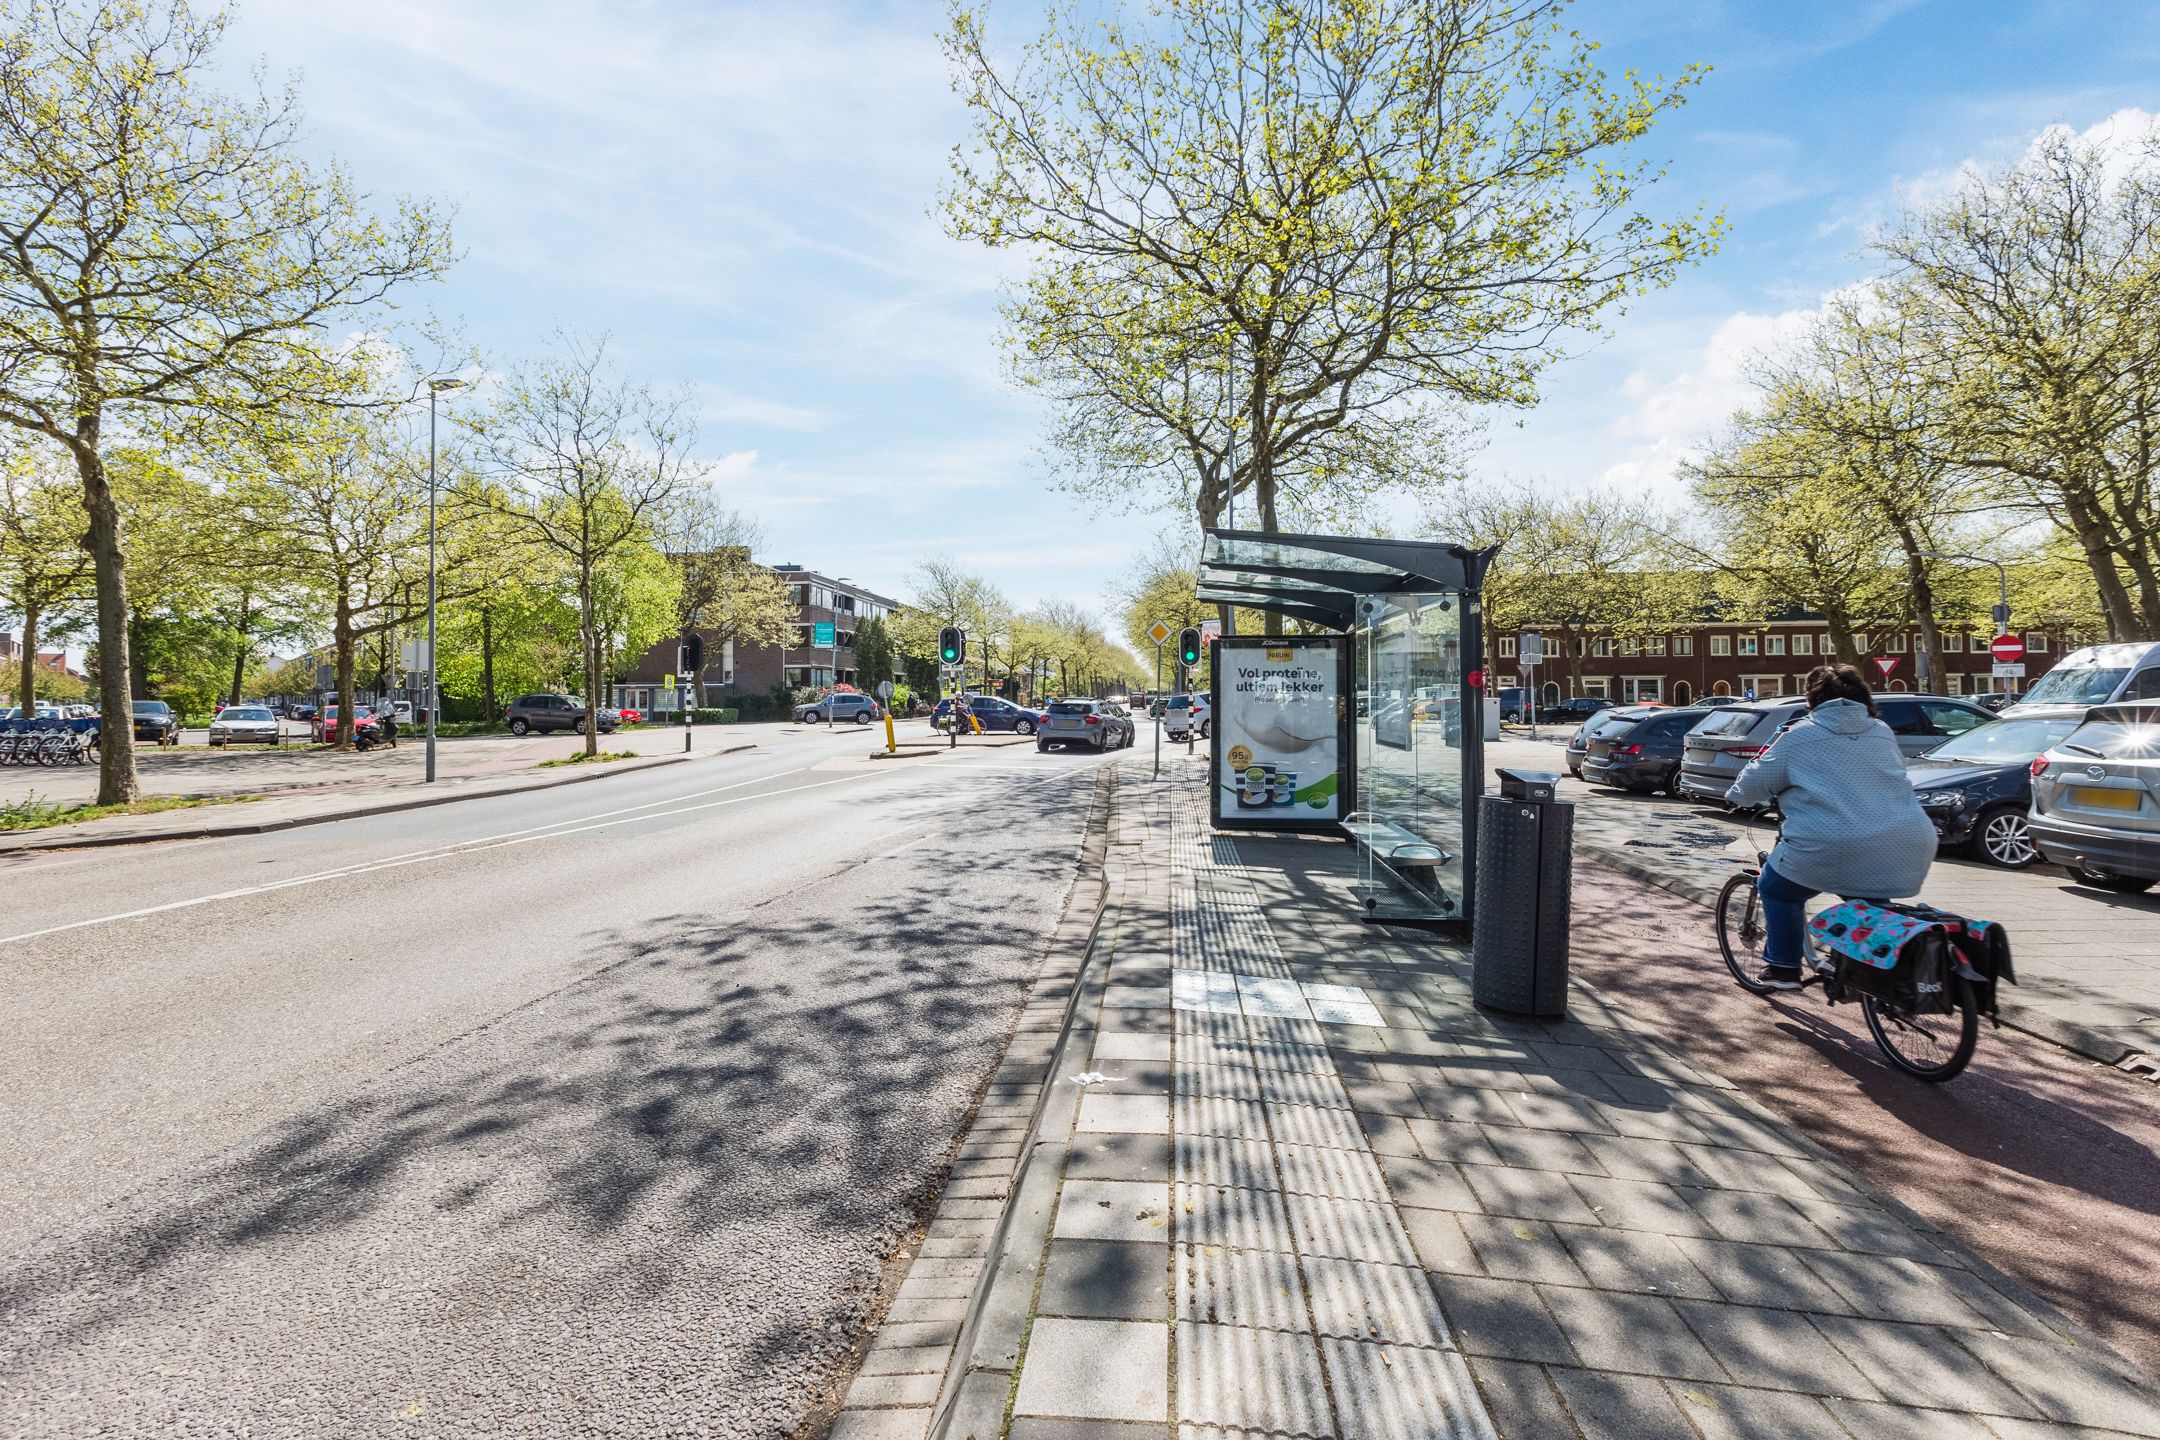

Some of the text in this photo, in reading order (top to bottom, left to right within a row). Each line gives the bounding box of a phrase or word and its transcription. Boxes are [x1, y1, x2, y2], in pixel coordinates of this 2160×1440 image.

[1238, 667, 1322, 681] Vol proteïne,
[1281, 681, 1324, 692] lekker
